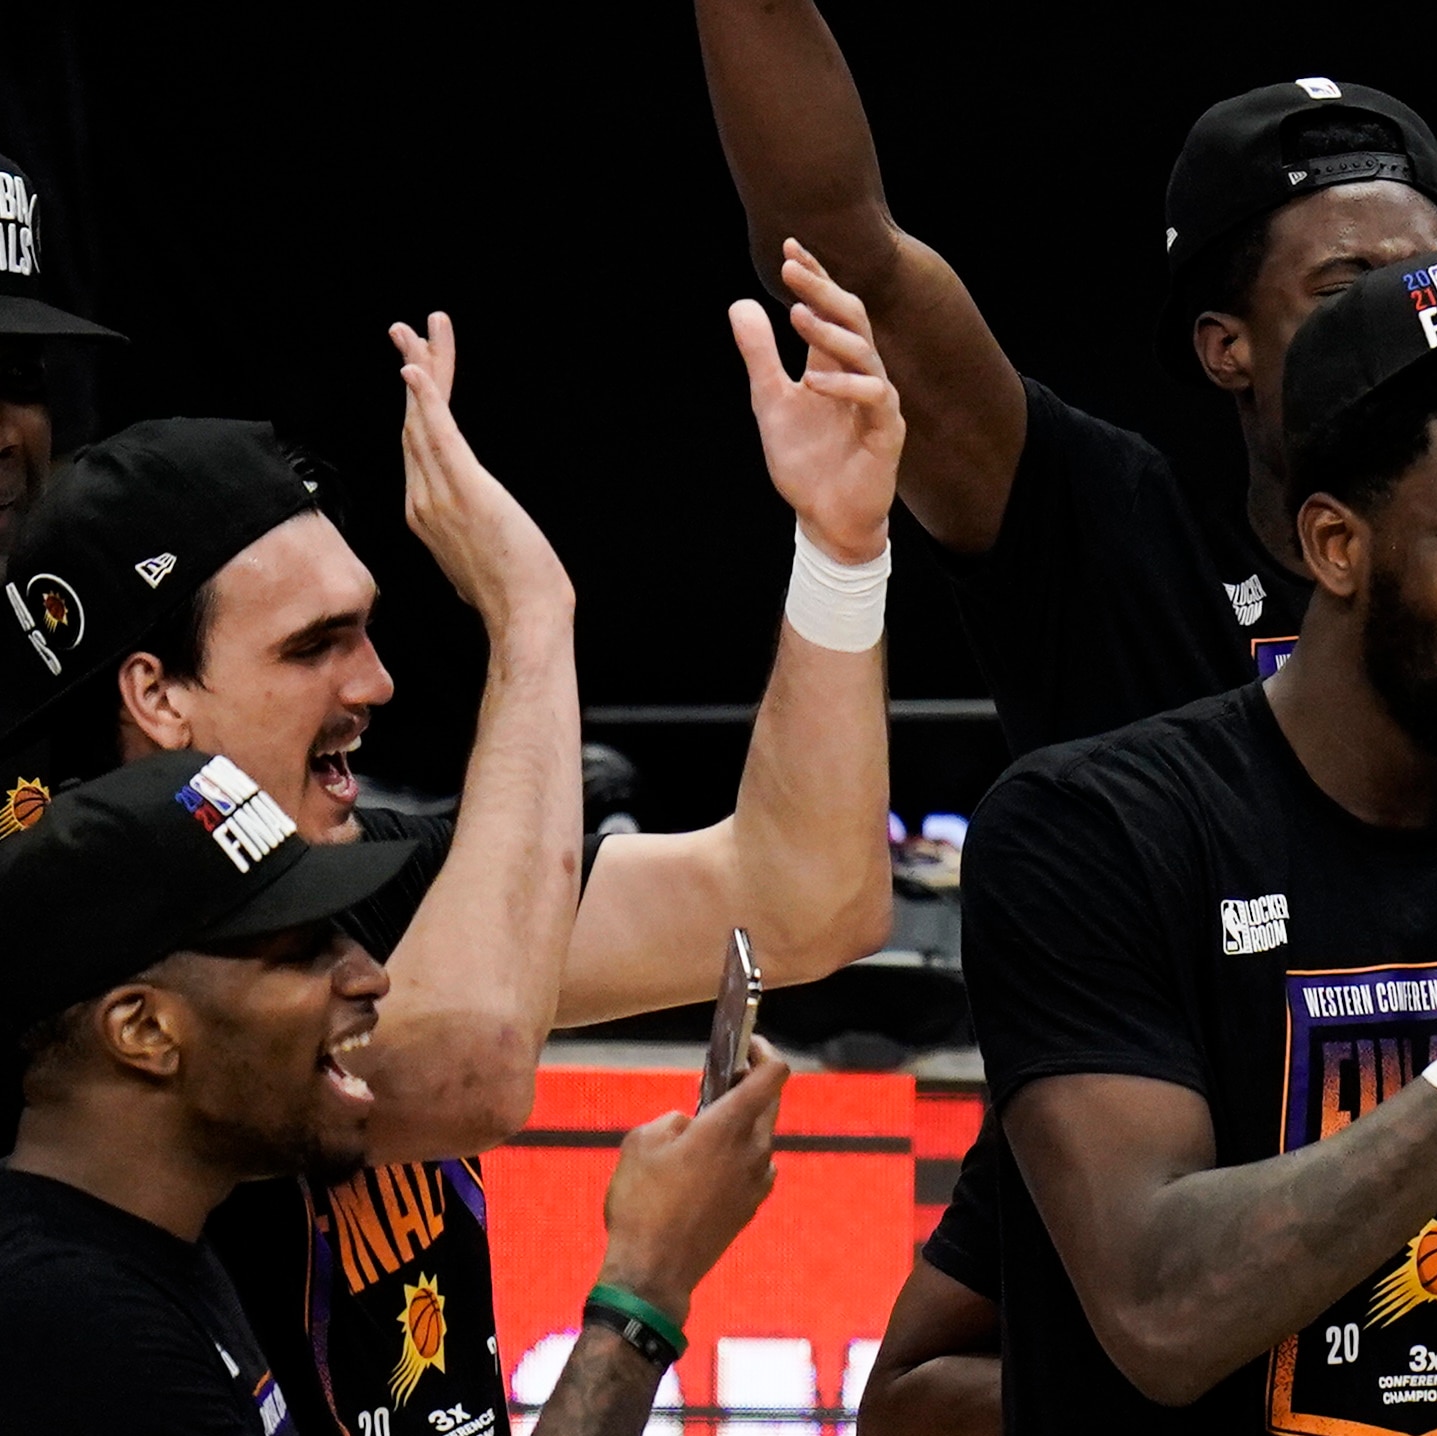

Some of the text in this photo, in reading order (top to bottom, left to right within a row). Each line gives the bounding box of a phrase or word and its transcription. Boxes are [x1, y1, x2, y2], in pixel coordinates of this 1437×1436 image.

[1403, 269, 1431, 291] 20
[1410, 288, 1437, 311] 21
[1249, 919, 1288, 953] ROOM
[1302, 984, 1374, 1018] WESTERN
[1325, 1323, 1360, 1365] 20
